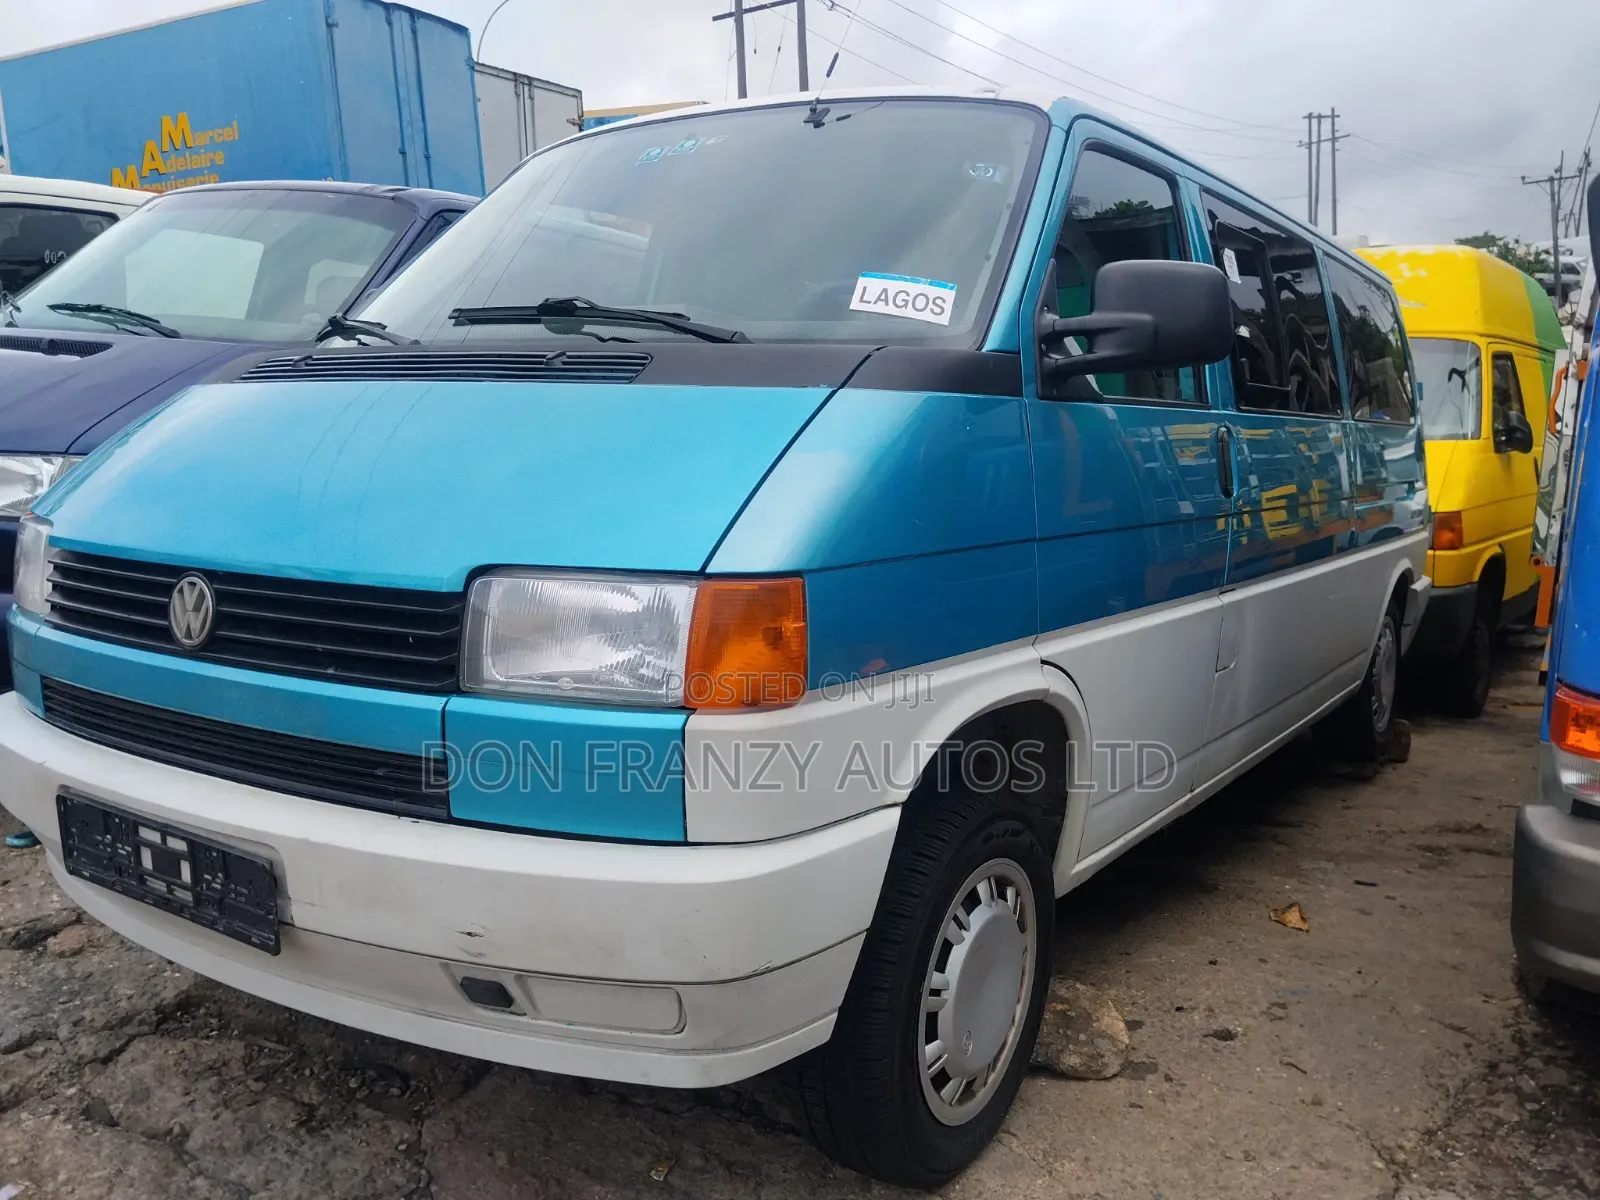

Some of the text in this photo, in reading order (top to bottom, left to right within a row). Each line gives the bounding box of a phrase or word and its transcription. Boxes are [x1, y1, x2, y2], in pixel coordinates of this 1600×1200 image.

[161, 112, 239, 153] Marcel
[141, 139, 225, 178] Adelaire
[858, 285, 947, 317] LAGOS
[170, 576, 213, 647] VW
